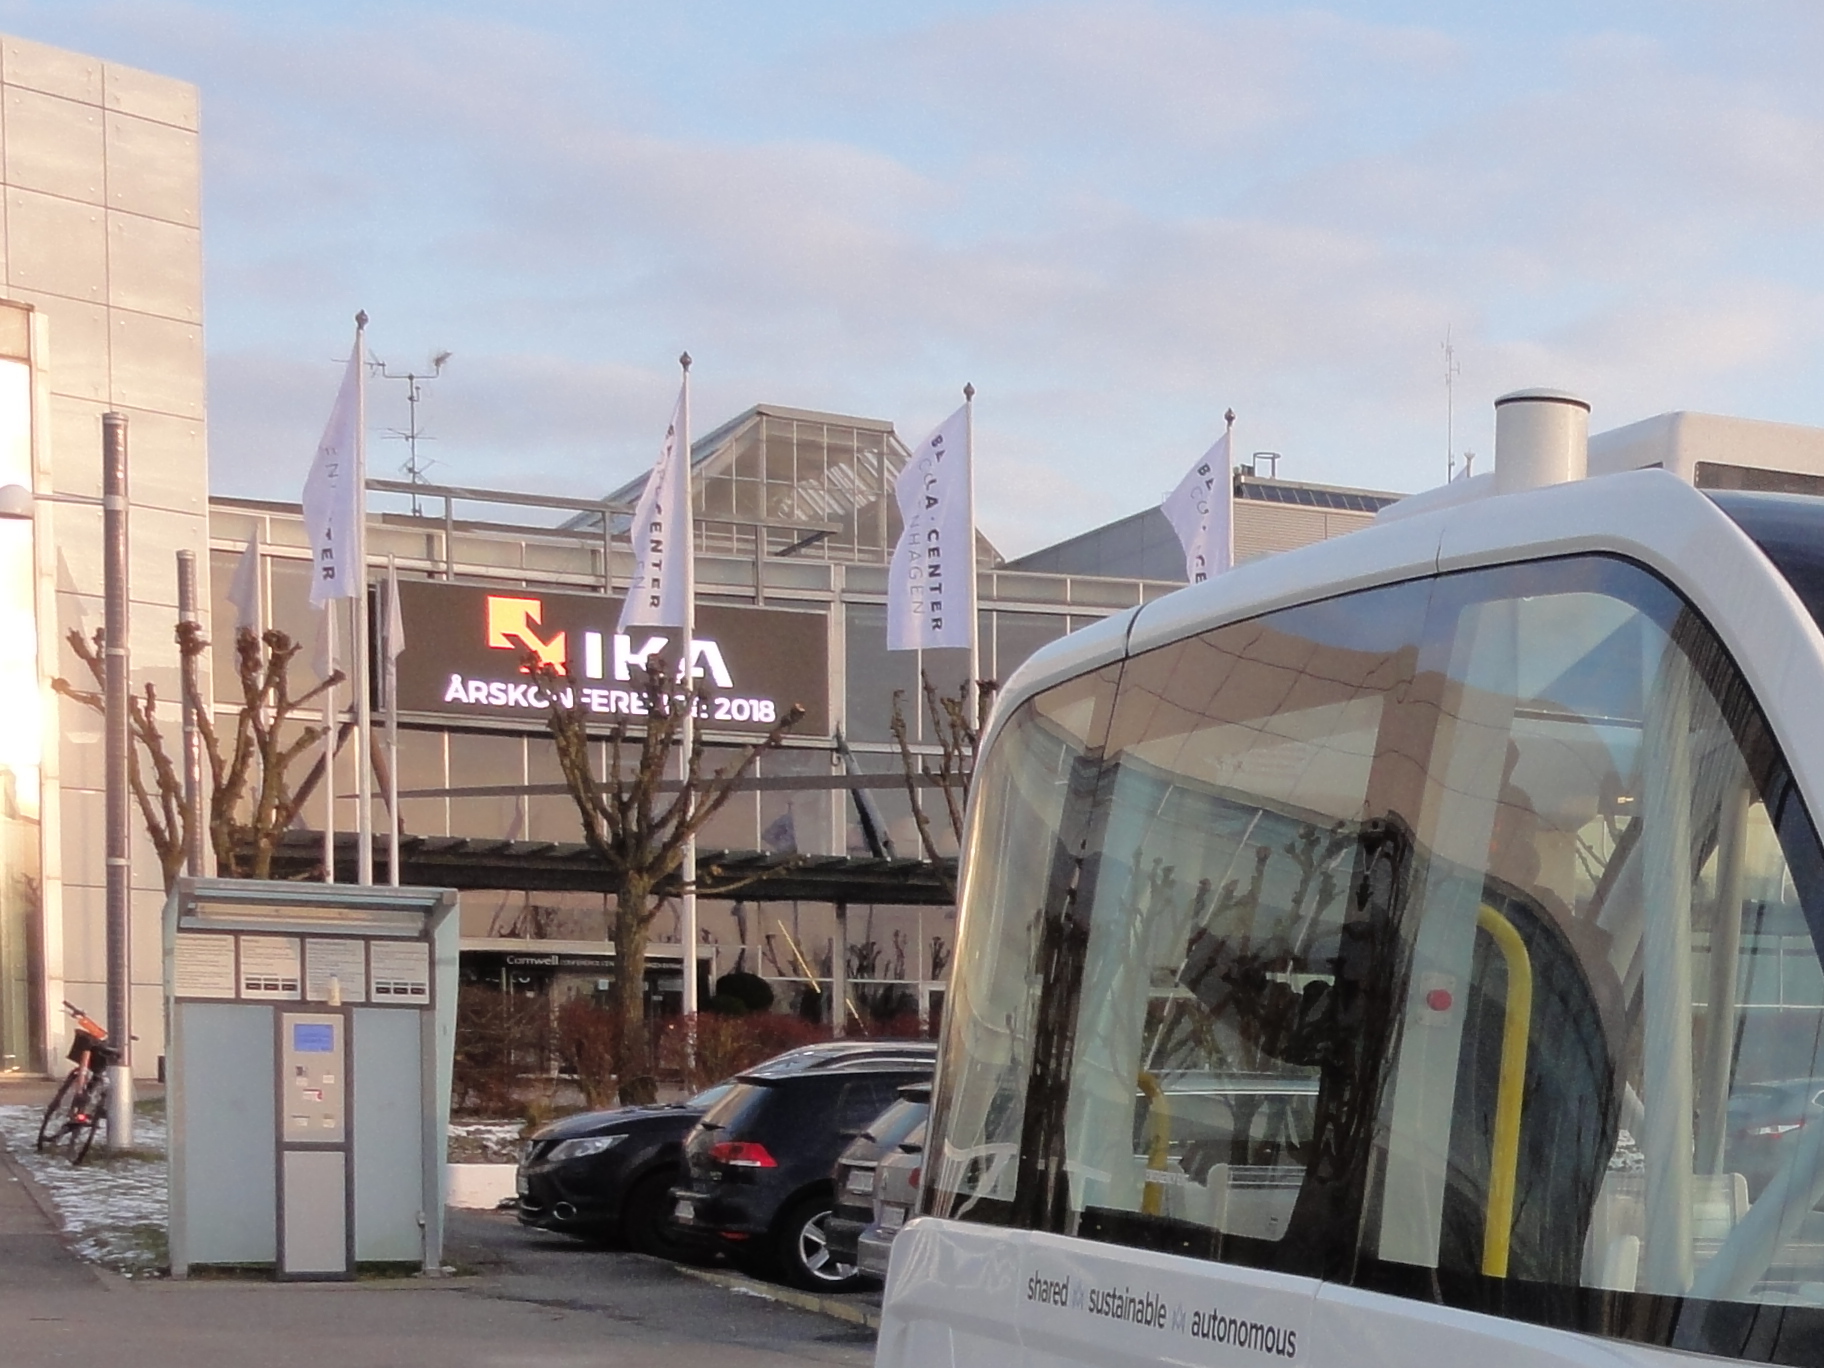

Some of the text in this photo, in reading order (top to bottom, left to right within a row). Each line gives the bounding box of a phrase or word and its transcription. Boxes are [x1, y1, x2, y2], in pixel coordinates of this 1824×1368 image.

[926, 528, 943, 631] CENTER
[584, 631, 734, 689] IKA
[714, 697, 776, 723] 2018
[1027, 1270, 1297, 1359] shared sustainable autonomous
